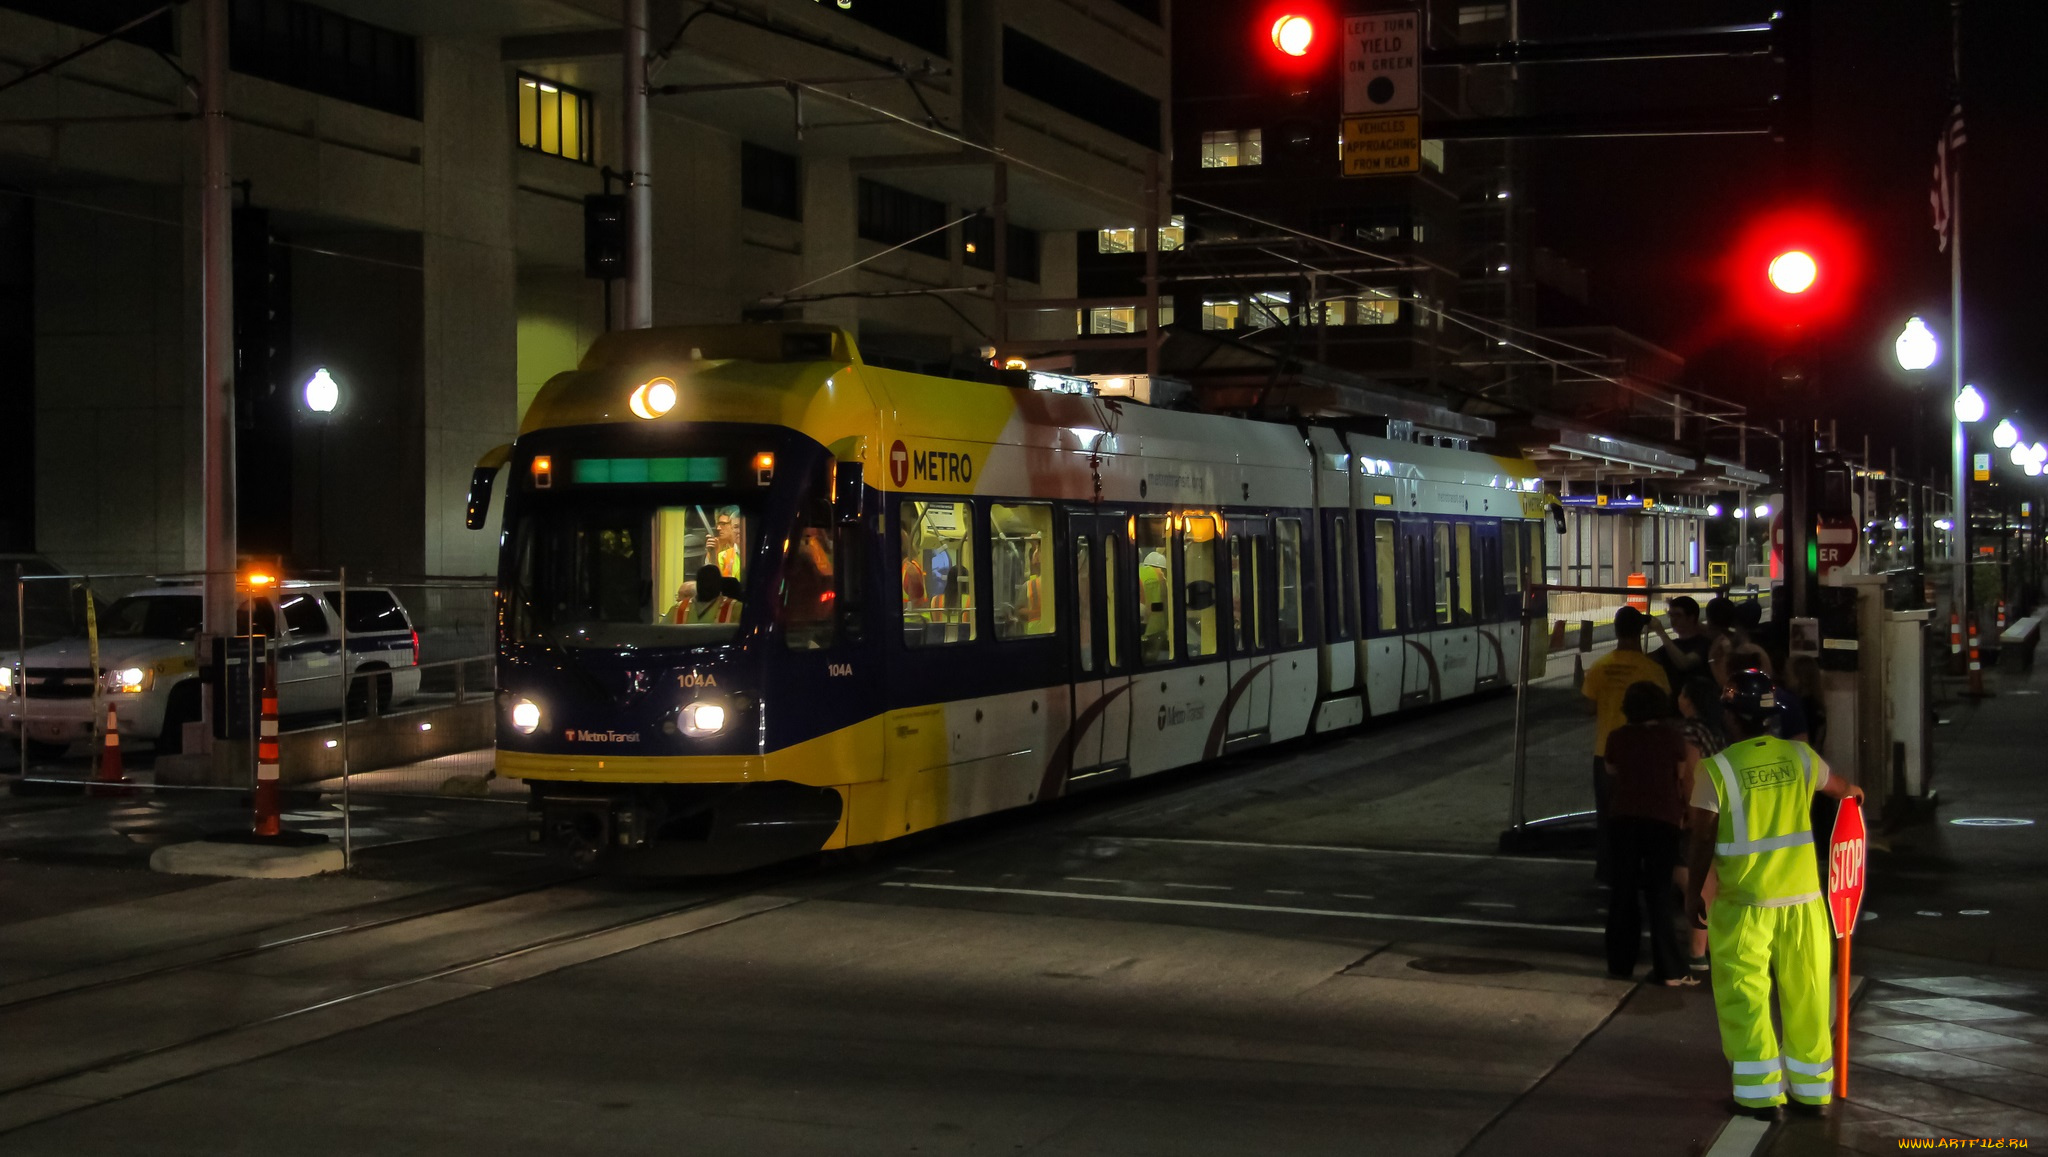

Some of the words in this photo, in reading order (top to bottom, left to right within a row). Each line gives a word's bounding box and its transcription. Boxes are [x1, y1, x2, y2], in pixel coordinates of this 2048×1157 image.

[1348, 21, 1375, 35] LEFT
[1384, 18, 1413, 32] TURN
[1361, 37, 1401, 53] YIELD
[1349, 60, 1365, 73] ON
[1372, 57, 1413, 71] GREEN
[1357, 120, 1405, 134] VEHICLES
[1347, 138, 1417, 153] APPROACHING
[1353, 158, 1380, 170] FROM
[1385, 156, 1410, 169] REAR
[913, 449, 972, 483] METRO
[827, 663, 853, 677] 104A
[677, 674, 717, 688] 104A
[1745, 765, 1791, 785] EGAN
[1831, 838, 1863, 894] STOP
